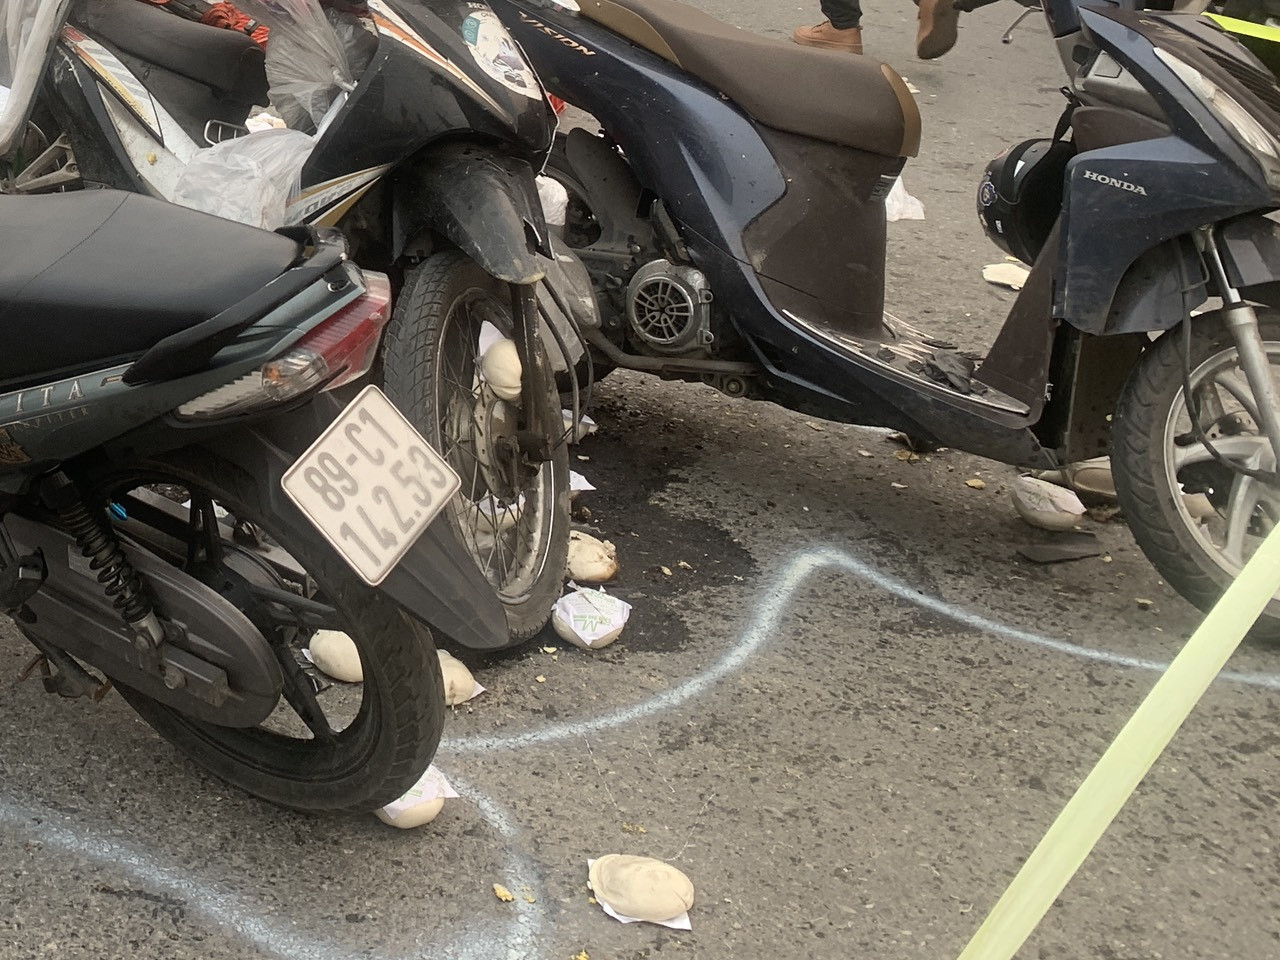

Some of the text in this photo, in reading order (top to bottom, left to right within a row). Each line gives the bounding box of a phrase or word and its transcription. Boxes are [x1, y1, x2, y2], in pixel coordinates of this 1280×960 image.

[518, 11, 597, 56] VISION
[1083, 170, 1147, 196] HONDA
[303, 407, 399, 512] 89-C1
[339, 445, 447, 567] 142.53
